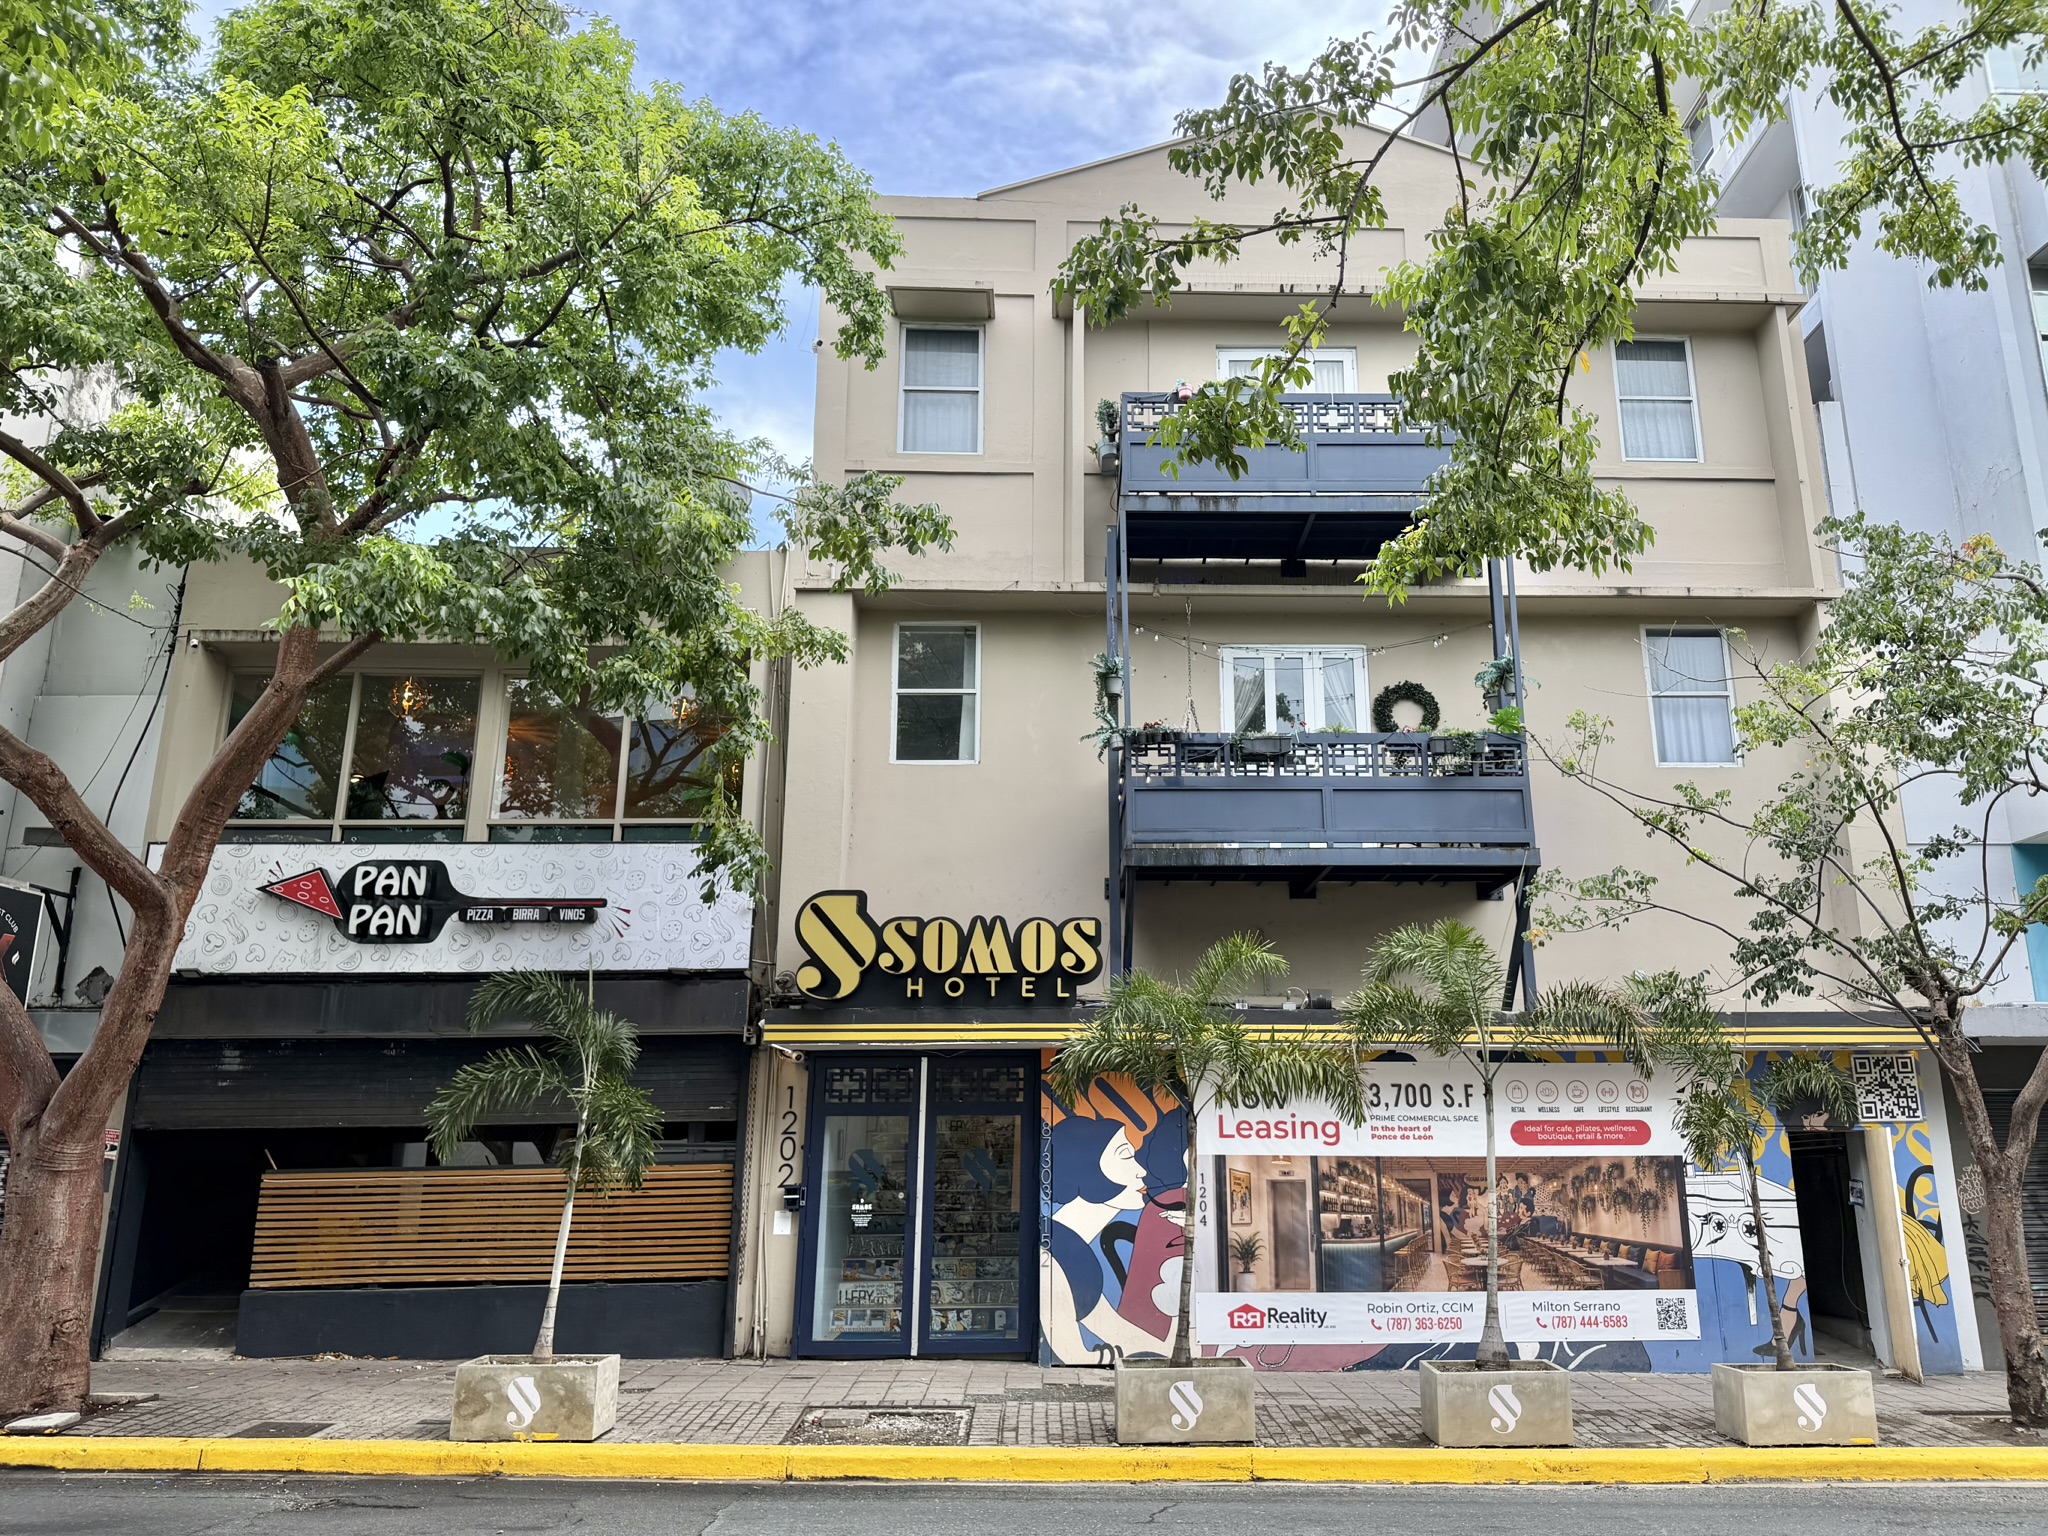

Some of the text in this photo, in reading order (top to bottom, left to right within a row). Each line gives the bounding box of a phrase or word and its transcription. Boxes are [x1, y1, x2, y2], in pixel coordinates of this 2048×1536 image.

[354, 865, 427, 896] PAN
[5, 913, 19, 933] CLUB
[348, 904, 422, 935] PAN
[466, 907, 586, 921] PIZZA BIRRA VINOS
[878, 918, 1098, 974] SOMOS
[906, 976, 1070, 998] HOTEL
[1369, 1083, 1474, 1111] 3,700 S.F
[777, 1086, 798, 1188] 1202
[1218, 1113, 1341, 1146] Leasing
[1537, 1132, 1574, 1141] boutique,
[1575, 1132, 1594, 1140] retail
[1596, 1132, 1602, 1140] &
[1556, 1125, 1575, 1133] cafe,
[1576, 1125, 1602, 1134] pilates,
[1603, 1125, 1638, 1133] wellness,
[1199, 1172, 1208, 1227] 1204
[1367, 1302, 1474, 1315] Robin Ortiz, CCIM
[1532, 1301, 1621, 1312] Milton Serrano
[1267, 1307, 1328, 1329] Reality
[1386, 1317, 1463, 1332] (787) 363-6250
[1551, 1315, 1629, 1330] (787) 444-6583
